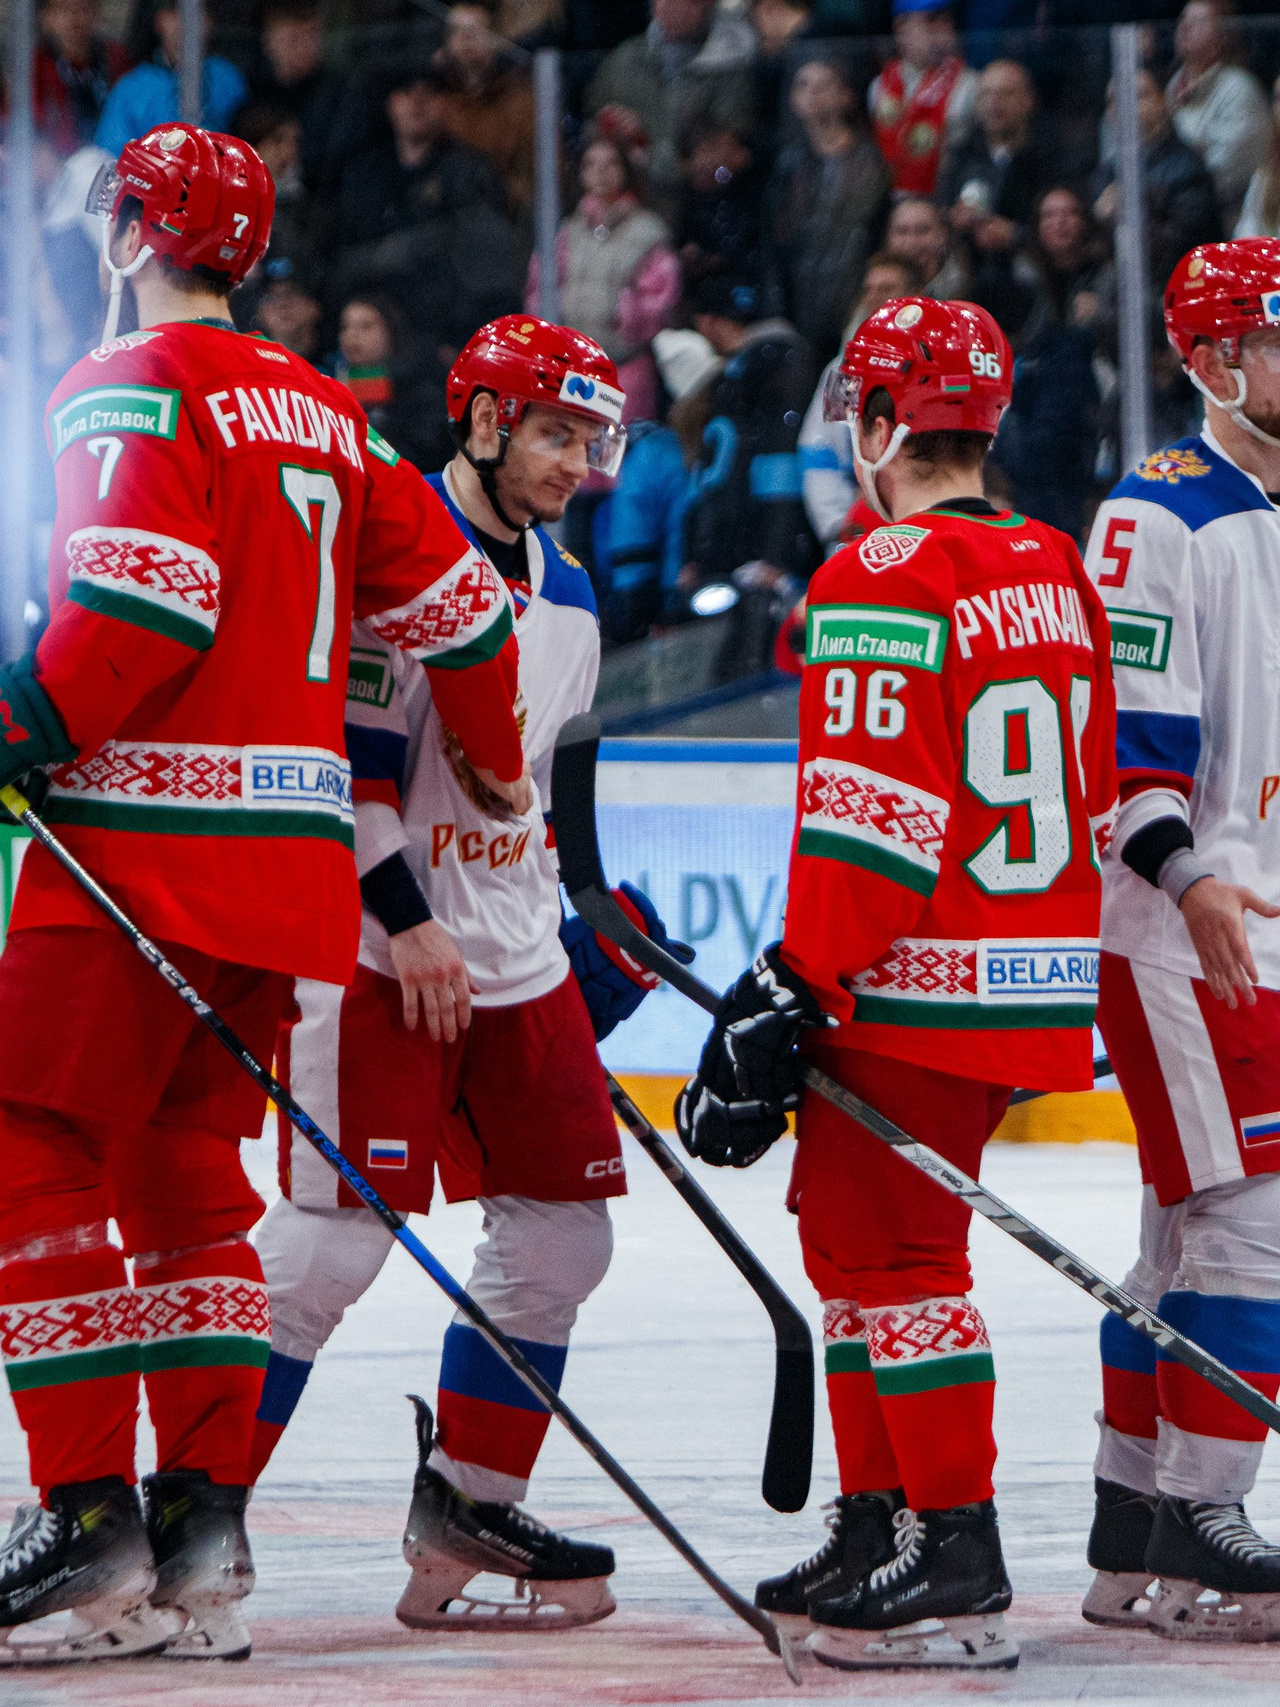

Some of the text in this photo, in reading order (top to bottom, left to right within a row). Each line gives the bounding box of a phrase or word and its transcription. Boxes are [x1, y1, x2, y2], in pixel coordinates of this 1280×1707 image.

[126, 173, 152, 191] CCM
[233, 212, 249, 239] 7
[868, 356, 900, 370] CCM
[968, 350, 1002, 379] 96
[86, 436, 125, 501] 7
[278, 462, 342, 684] 7
[1098, 517, 1137, 588] 5
[824, 667, 909, 739] 96
[940, 1168, 964, 1190] PRO
[1053, 1254, 1176, 1347] CCM
